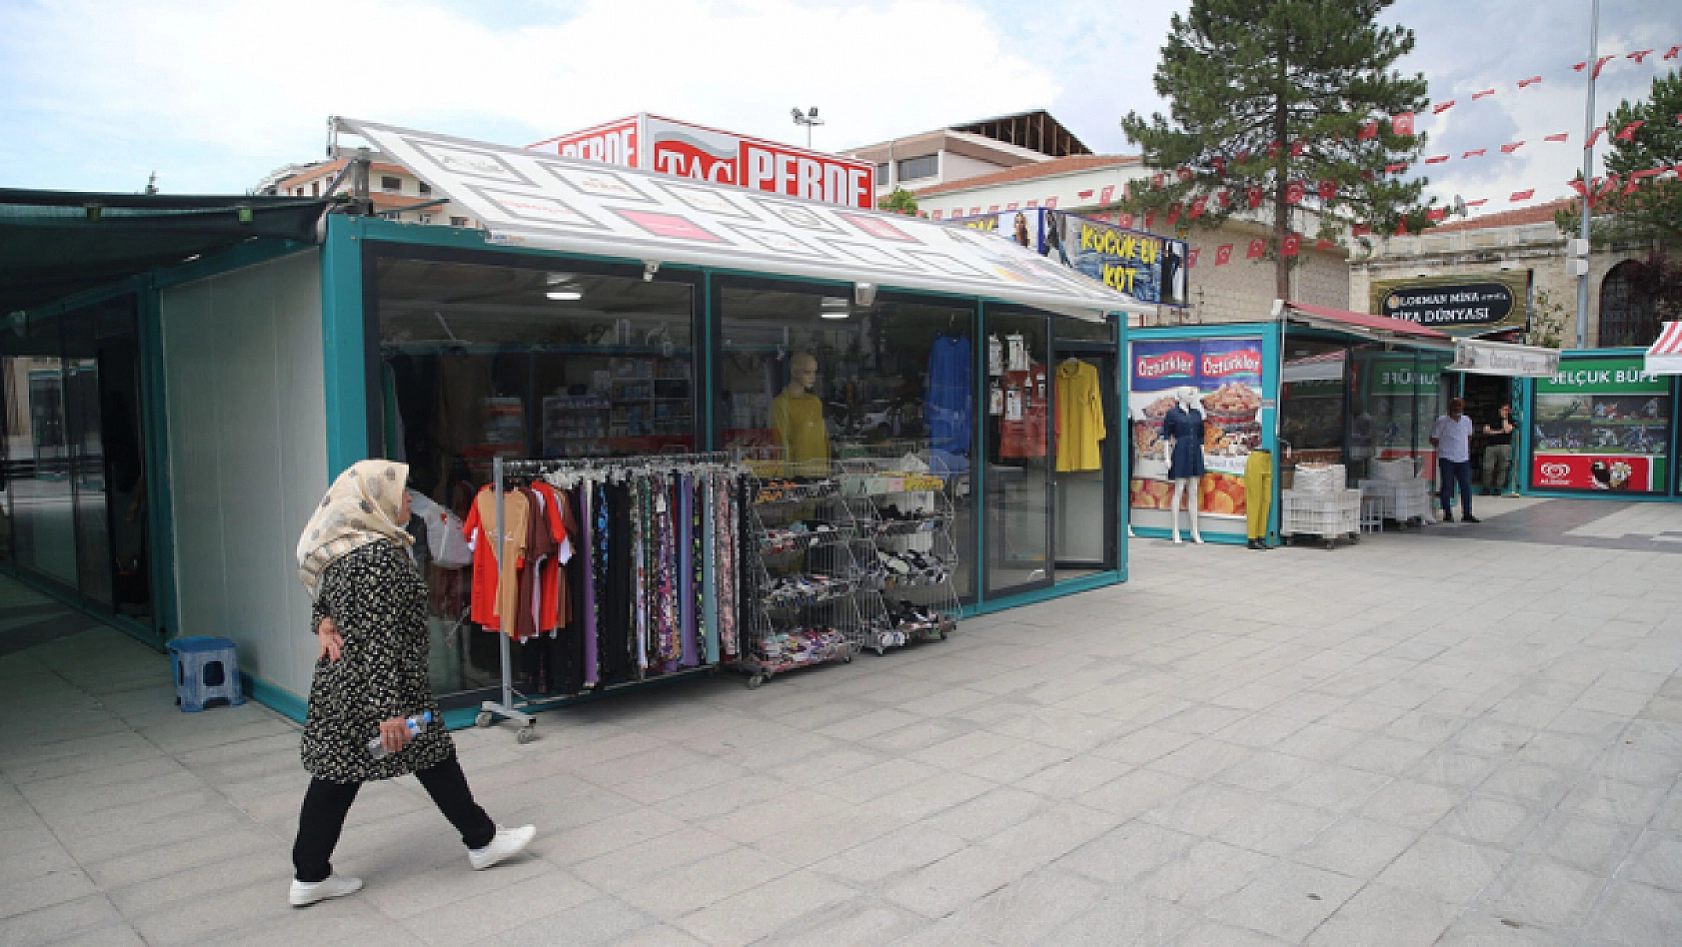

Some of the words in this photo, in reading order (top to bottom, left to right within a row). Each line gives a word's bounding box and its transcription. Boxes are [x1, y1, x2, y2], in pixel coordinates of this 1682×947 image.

[749, 147, 867, 207] PERDE
[1138, 355, 1193, 376] Öztürkler
[1203, 354, 1260, 376] Öztürkler
